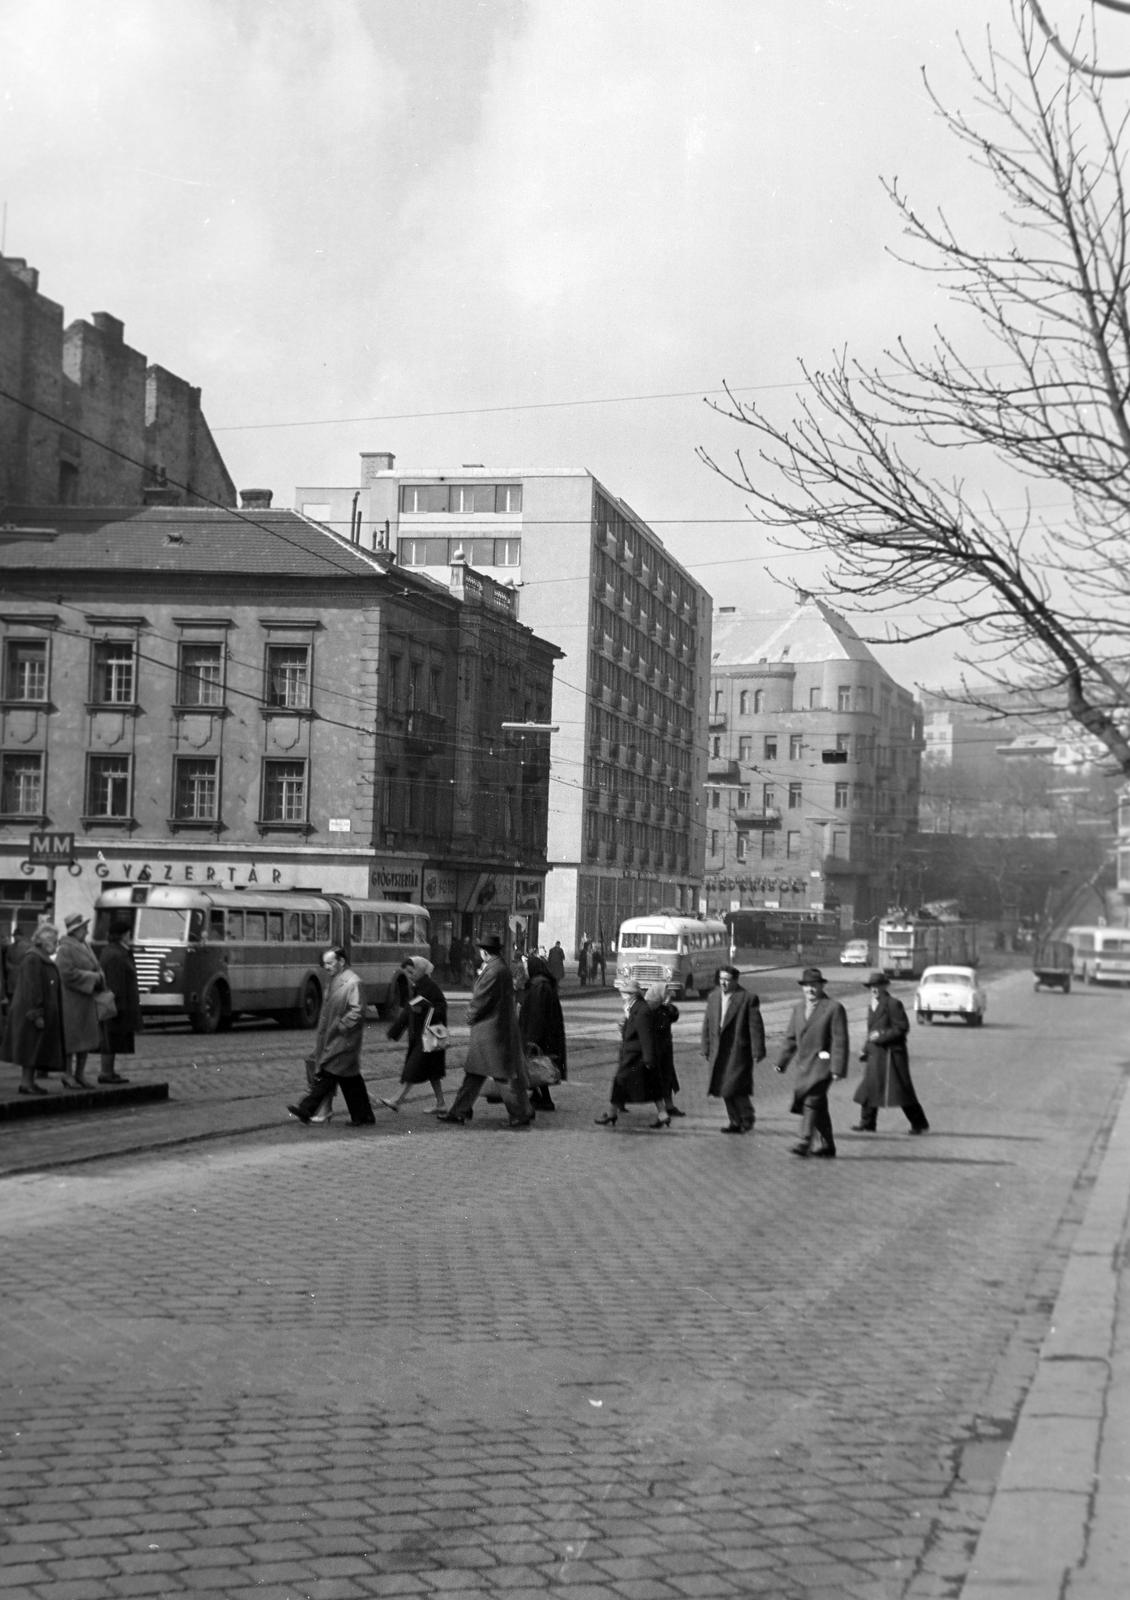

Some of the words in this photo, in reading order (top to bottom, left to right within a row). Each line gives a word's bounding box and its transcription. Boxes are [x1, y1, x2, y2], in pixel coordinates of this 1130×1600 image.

[33, 836, 70, 853] MM
[20, 857, 282, 884] GÓGYSZERTÁR
[371, 866, 419, 889] GYÓGYSZERTÁR
